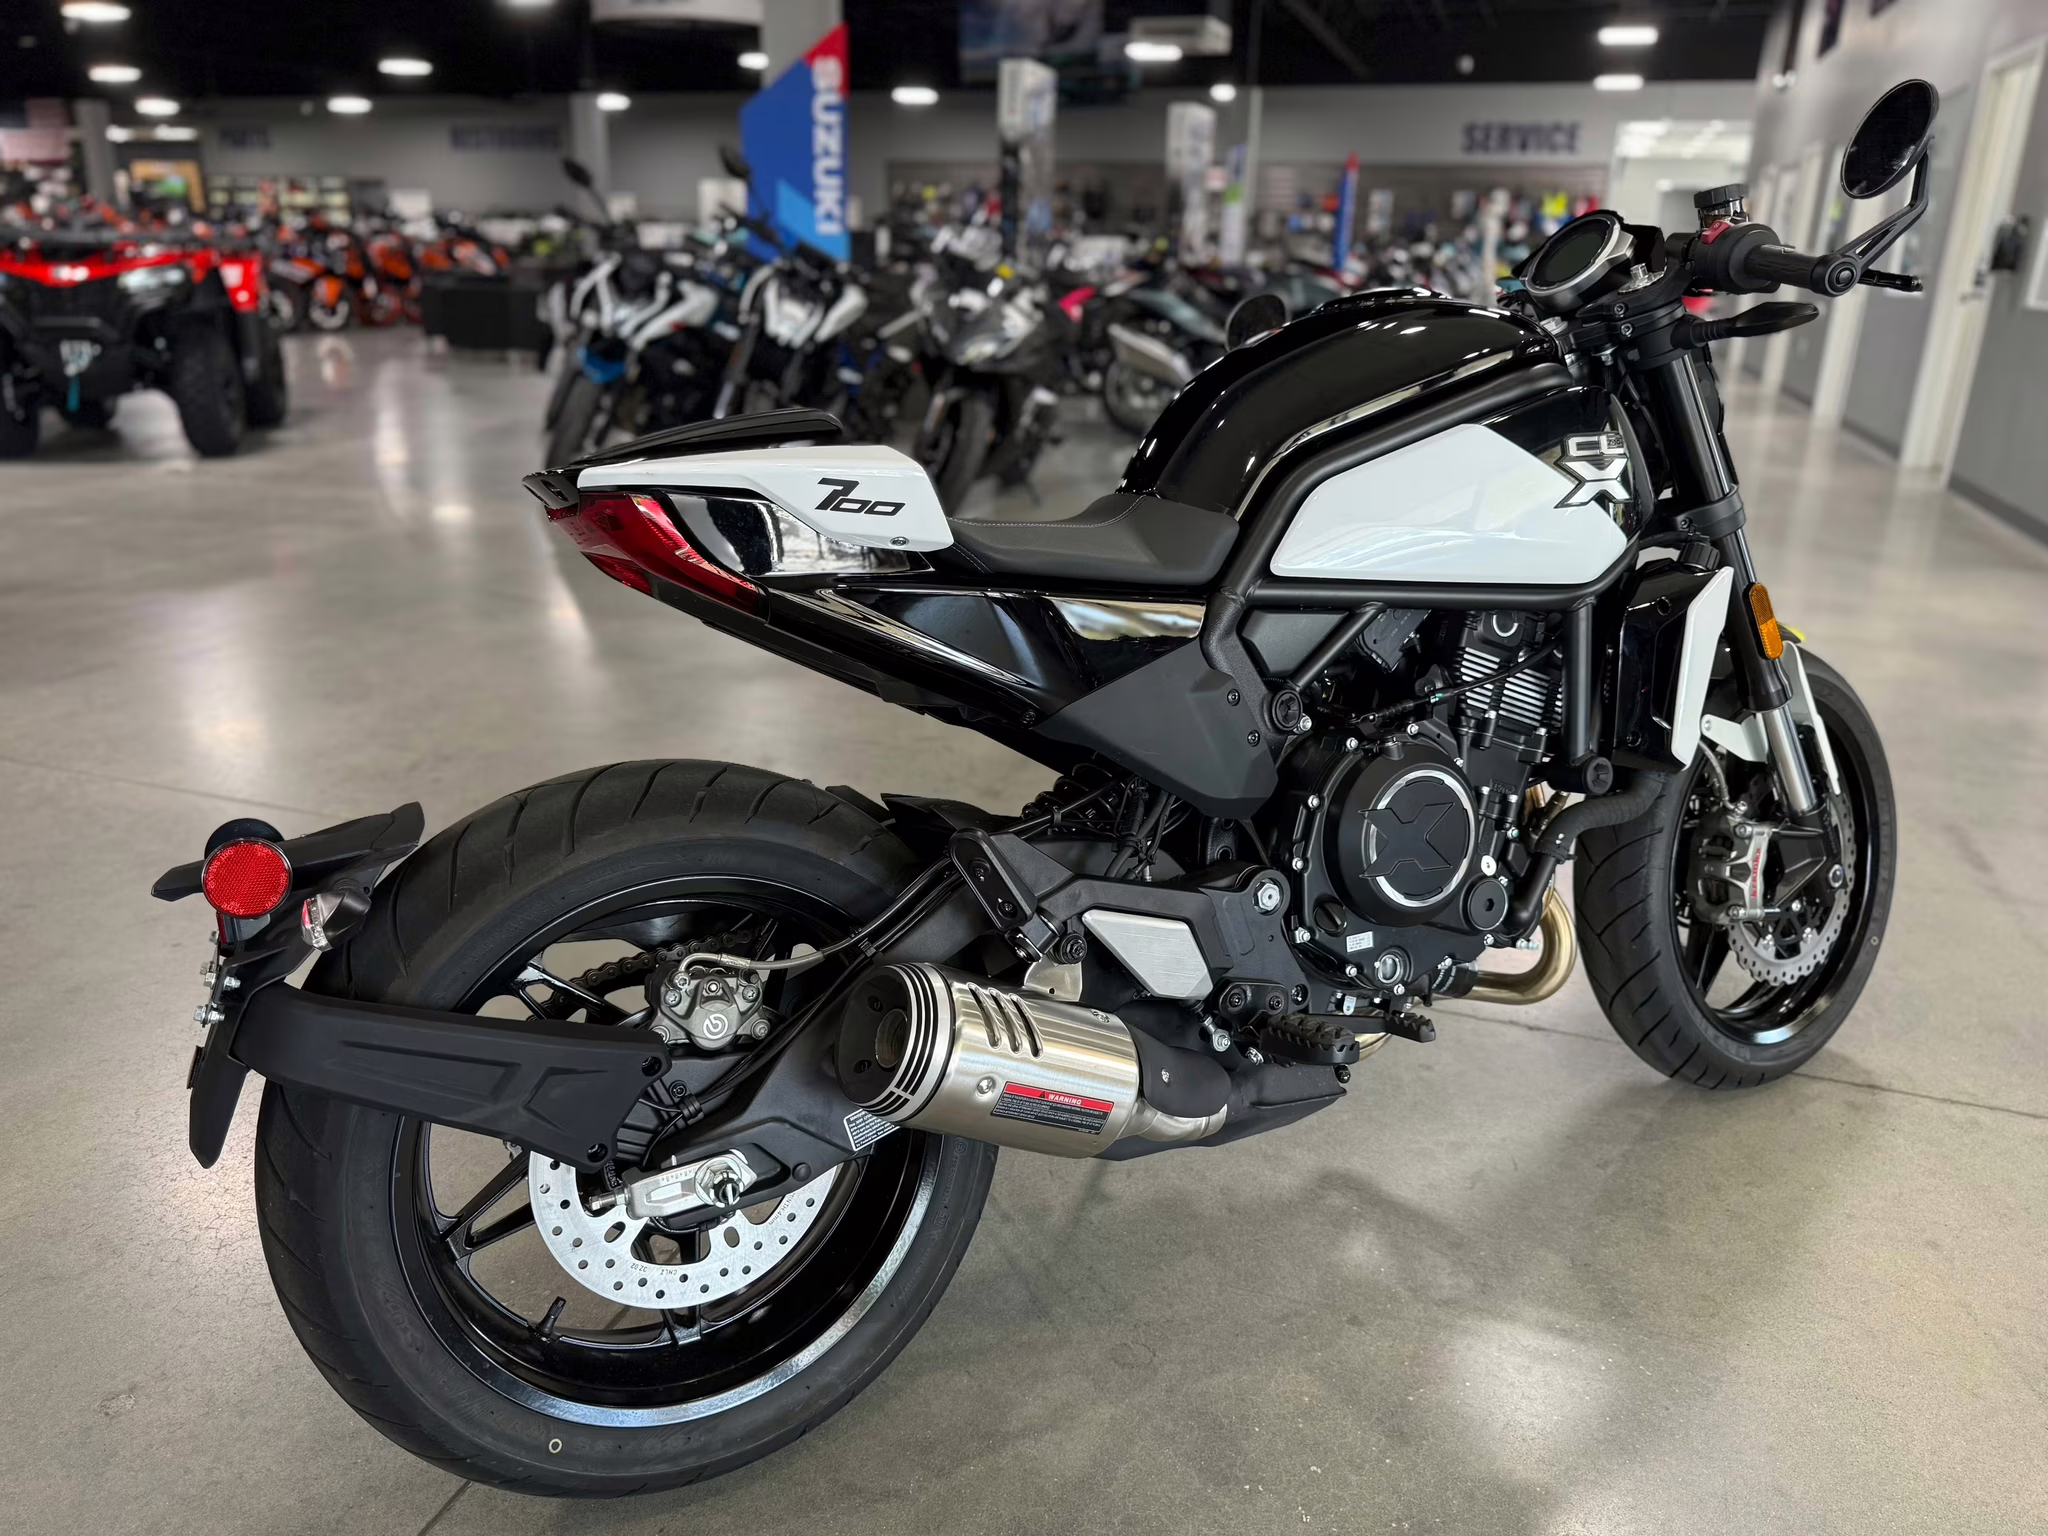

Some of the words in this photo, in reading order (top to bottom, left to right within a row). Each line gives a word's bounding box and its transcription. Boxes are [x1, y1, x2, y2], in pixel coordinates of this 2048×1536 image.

[811, 55, 845, 236] SUZUKI
[1461, 121, 1580, 156] SERVICE
[814, 477, 906, 517] 700
[1048, 1093, 1082, 1106] WARNING
